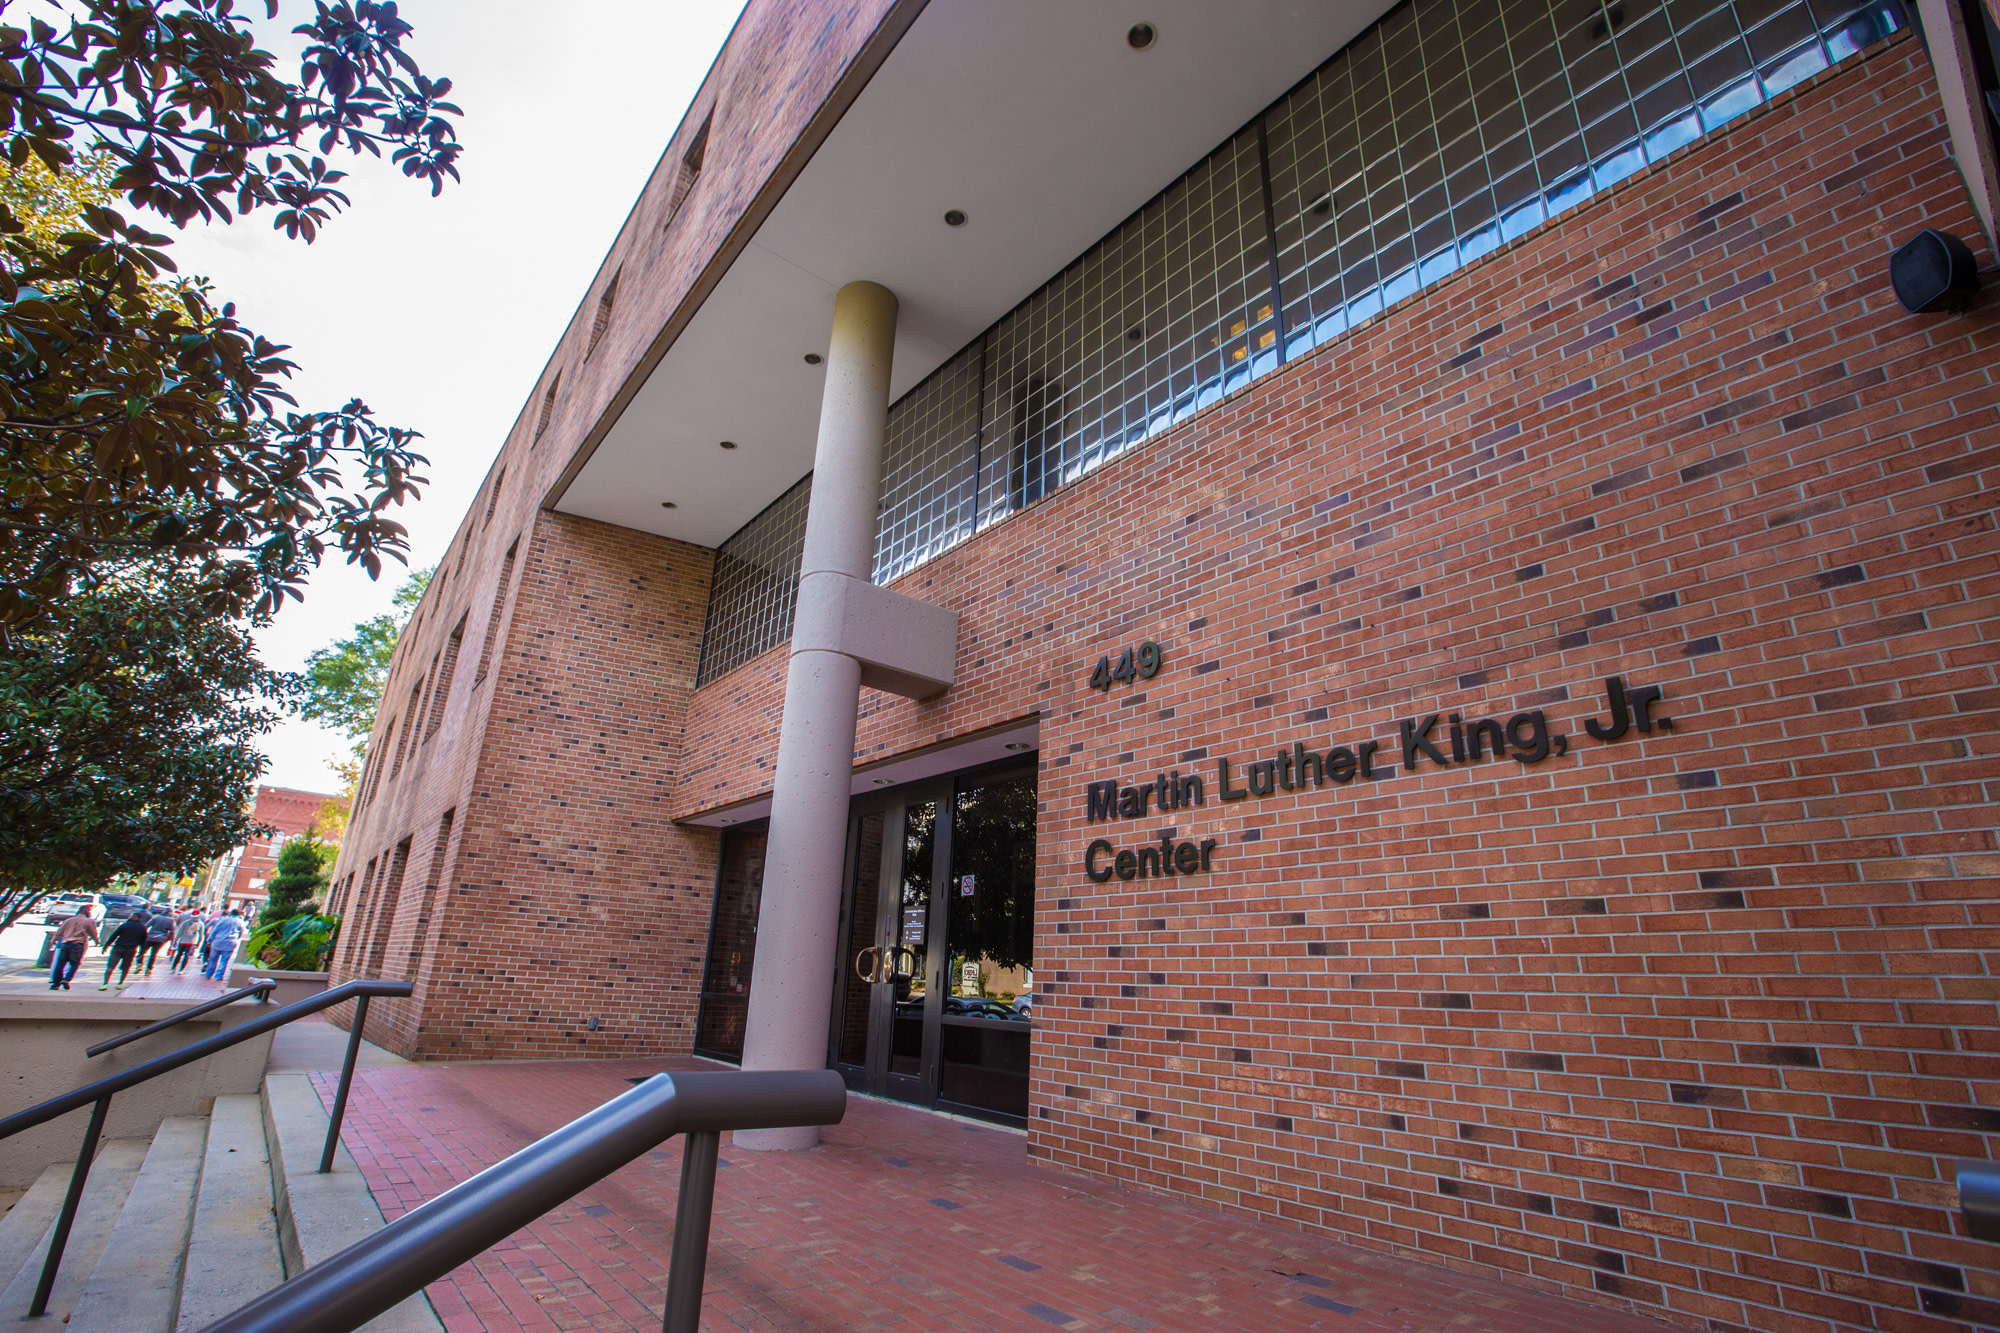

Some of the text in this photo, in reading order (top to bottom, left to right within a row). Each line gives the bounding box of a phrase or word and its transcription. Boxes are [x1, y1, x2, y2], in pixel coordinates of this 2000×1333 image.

[1090, 641, 1161, 692] 449
[1087, 677, 1673, 822] Martin Luther King, Jr.
[1086, 836, 1216, 882] Center
